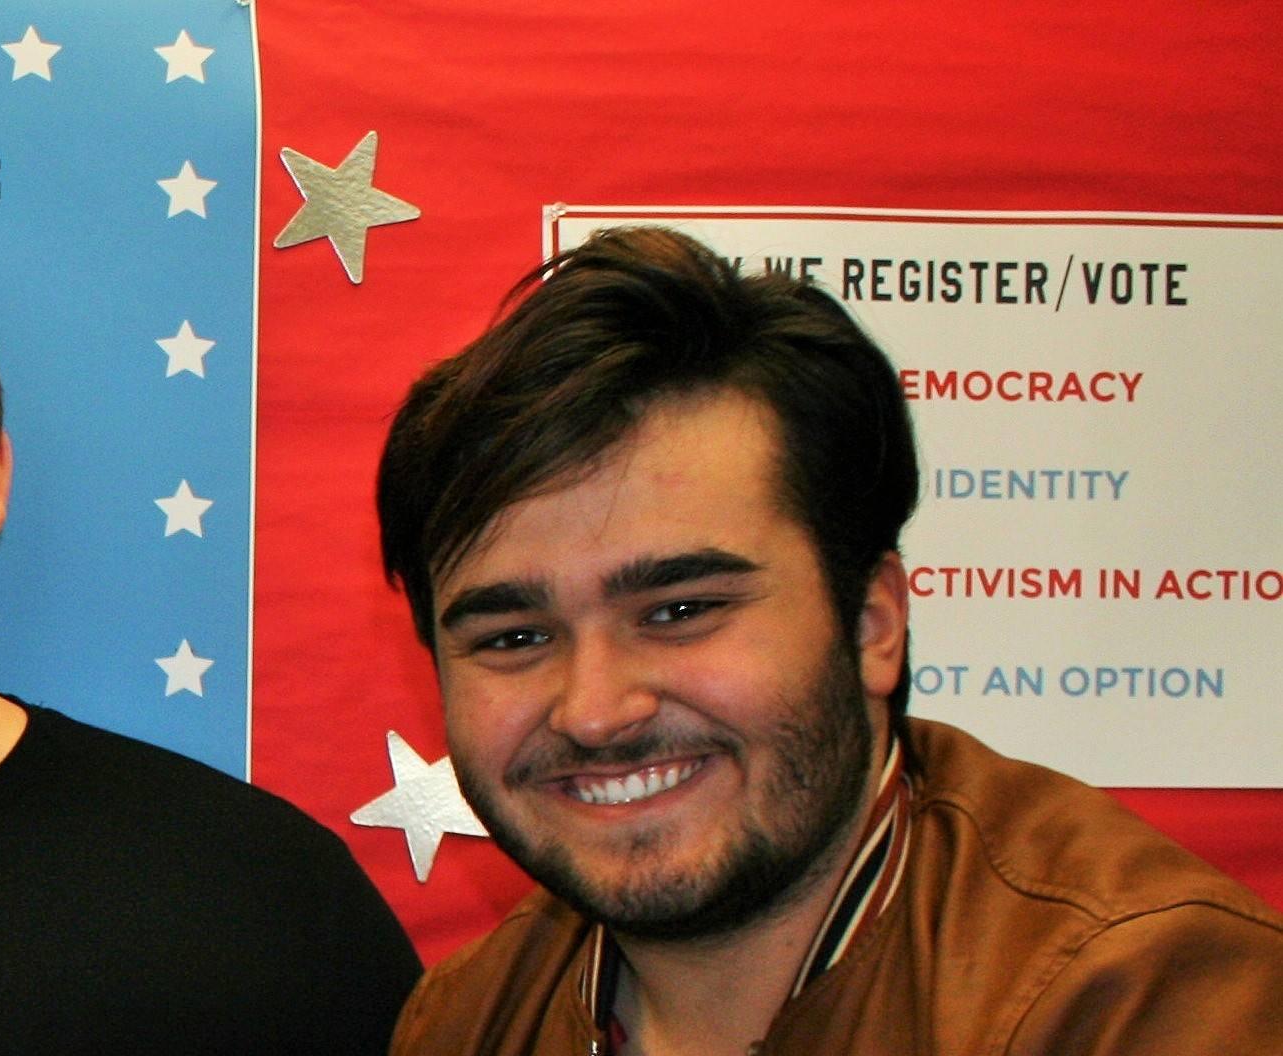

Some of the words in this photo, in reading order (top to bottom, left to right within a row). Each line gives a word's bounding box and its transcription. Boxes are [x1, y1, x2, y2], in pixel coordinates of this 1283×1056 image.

[900, 370, 1144, 402] EMOCRACY
[936, 469, 1129, 500] IDENTITY
[909, 565, 1086, 600] CTIVISM
[1100, 569, 1140, 599] IN
[1155, 569, 1283, 600] ACTIO
[913, 665, 969, 696] OT
[982, 667, 1043, 696] AN
[1060, 667, 1223, 697] OPTION
